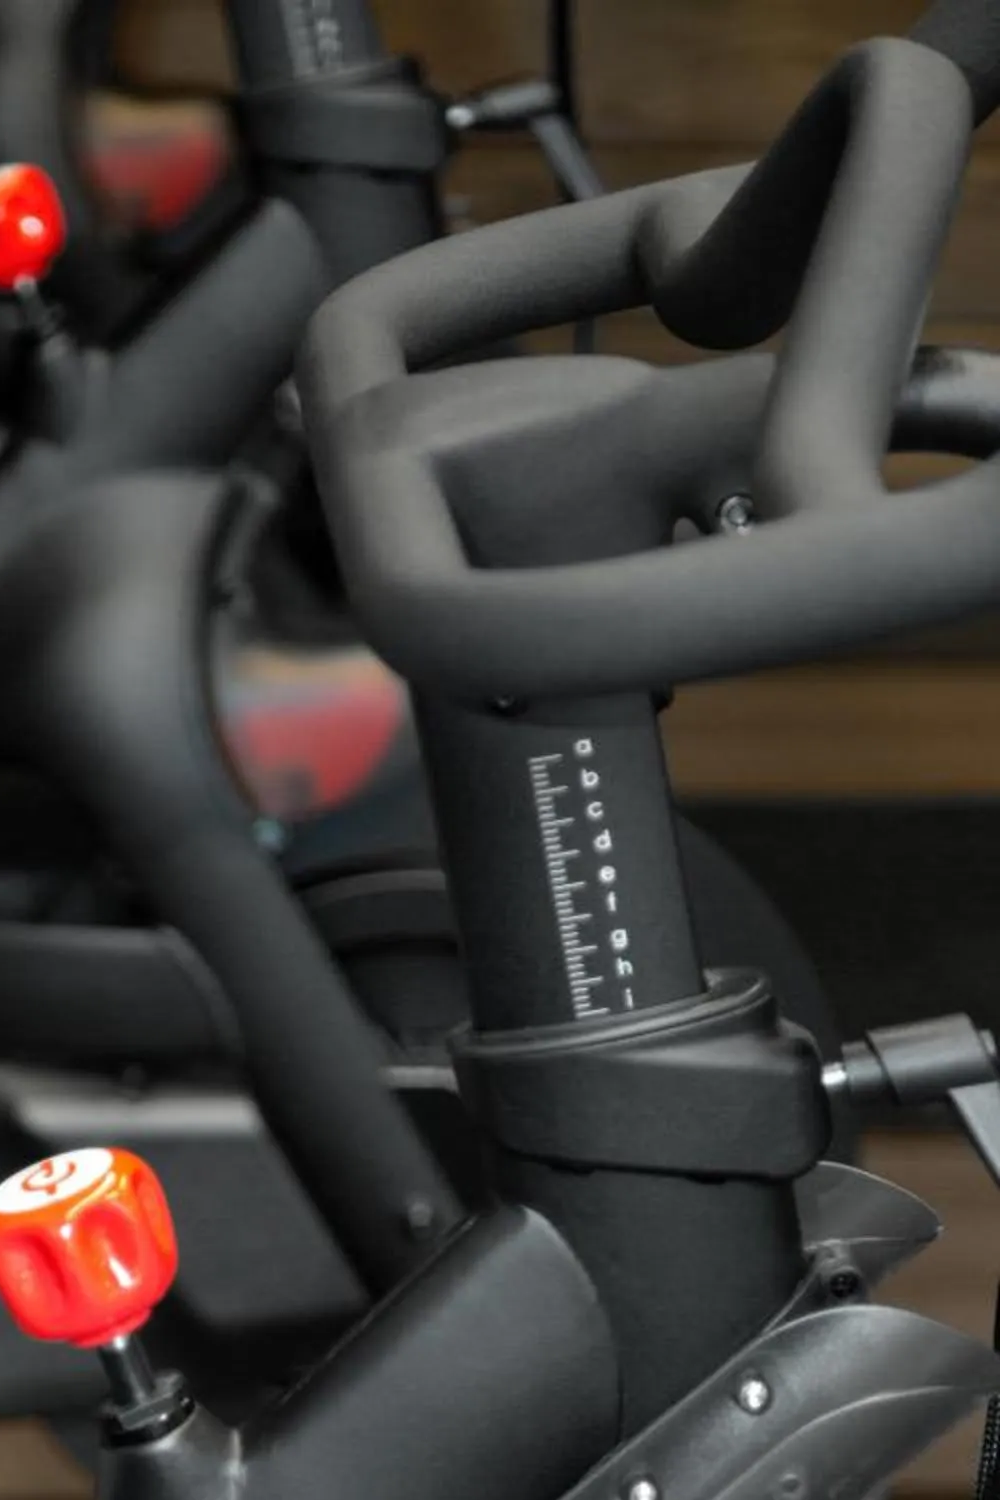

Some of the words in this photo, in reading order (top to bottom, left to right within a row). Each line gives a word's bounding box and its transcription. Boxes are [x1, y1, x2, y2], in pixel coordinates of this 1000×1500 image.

[574, 739, 593, 756] a
[581, 768, 599, 789] b
[586, 801, 604, 820] c
[593, 829, 612, 852] d
[598, 865, 616, 885] e
[610, 928, 629, 951] g
[615, 956, 633, 977] h
